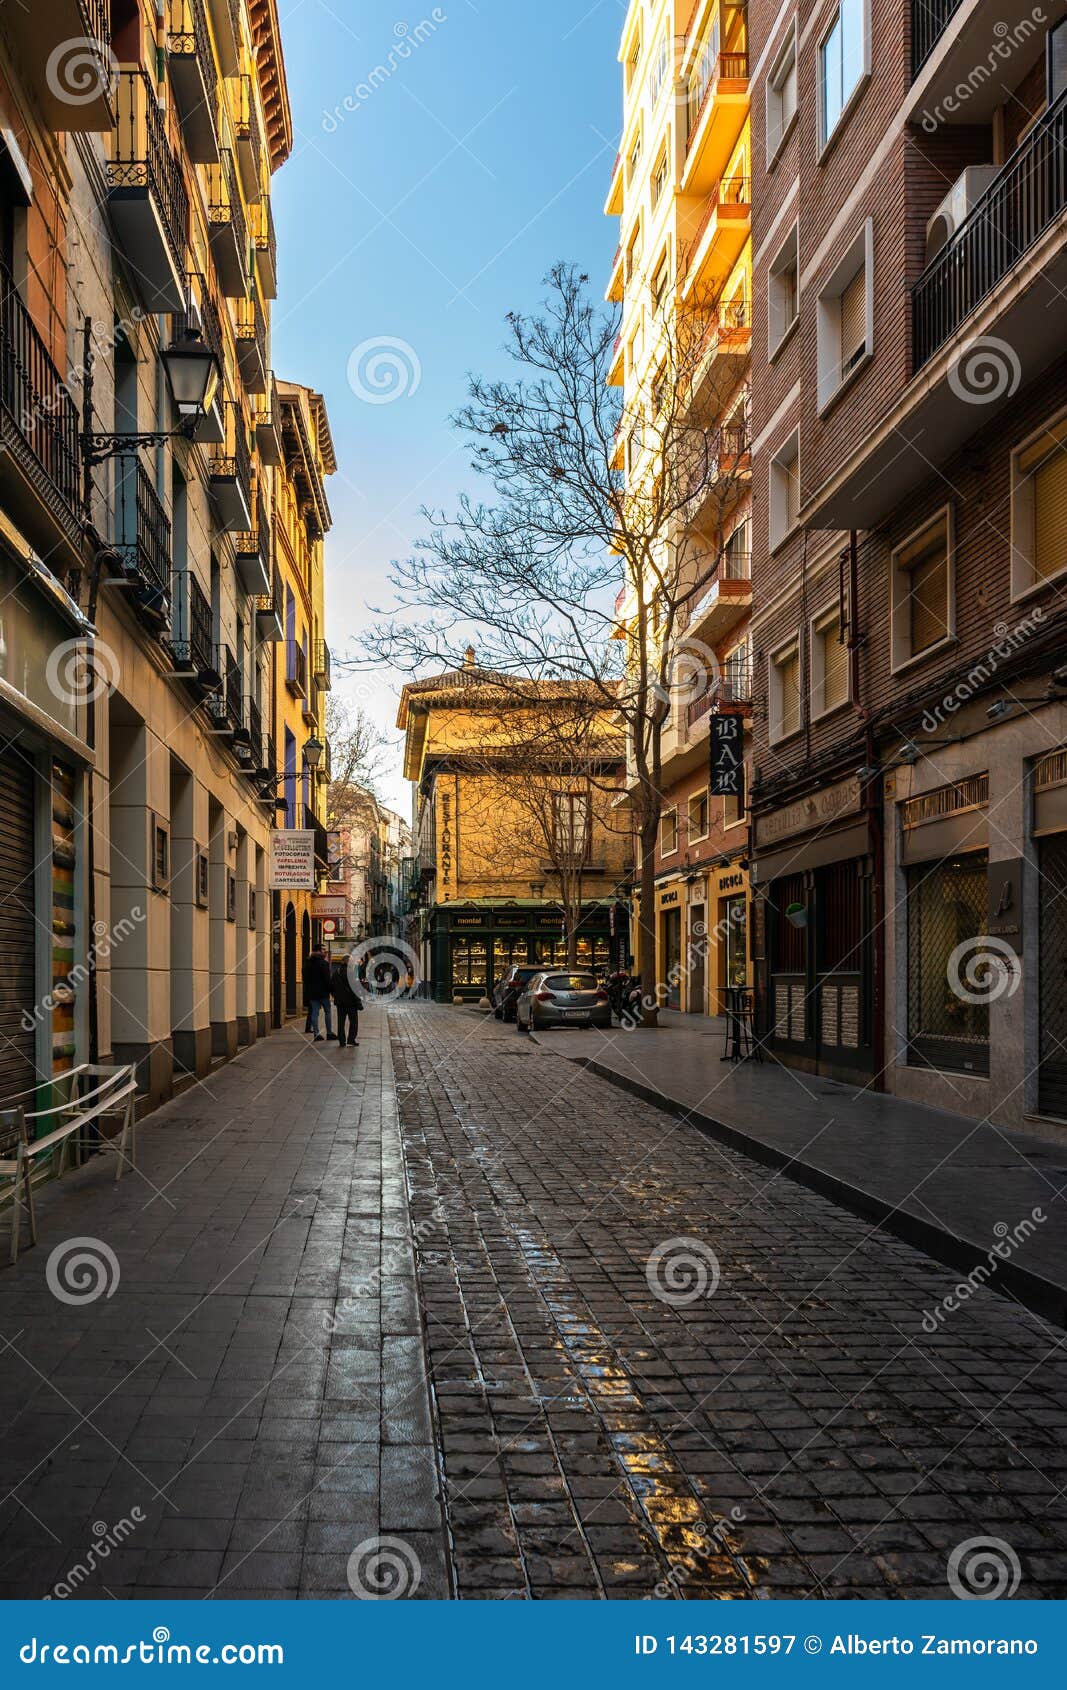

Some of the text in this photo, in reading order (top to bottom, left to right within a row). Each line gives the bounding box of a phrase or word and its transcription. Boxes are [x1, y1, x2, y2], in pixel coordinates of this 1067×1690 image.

[715, 717, 739, 792] BAR
[442, 793, 451, 885] RESTAURANTE
[457, 917, 482, 925] montal
[540, 917, 564, 925] monta
